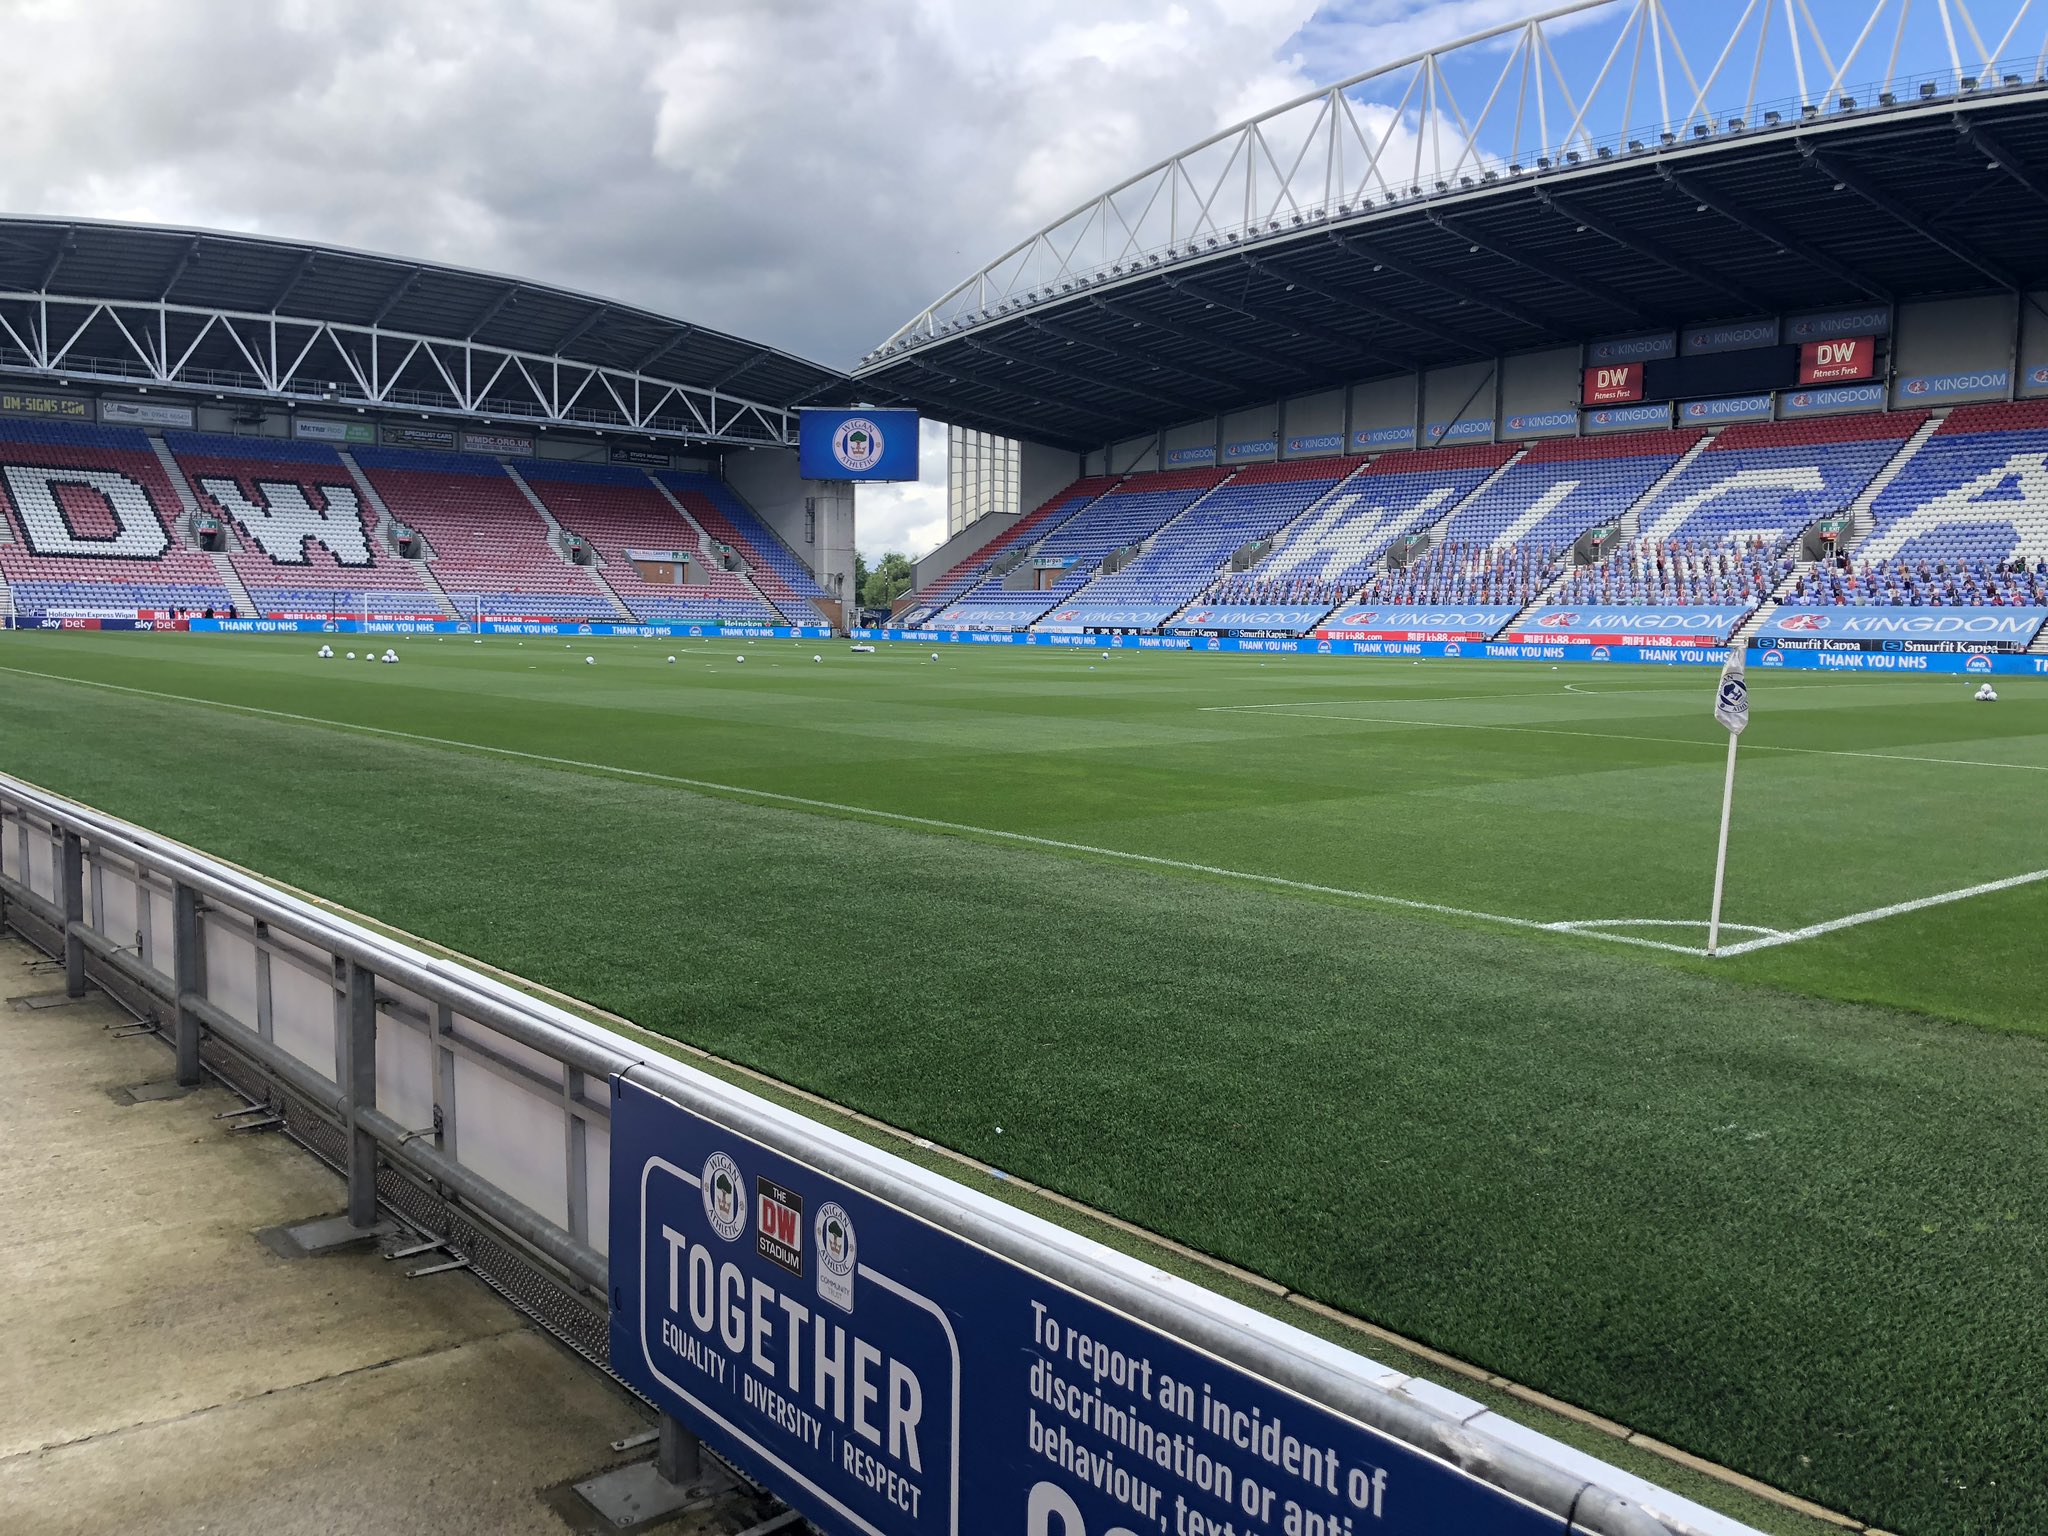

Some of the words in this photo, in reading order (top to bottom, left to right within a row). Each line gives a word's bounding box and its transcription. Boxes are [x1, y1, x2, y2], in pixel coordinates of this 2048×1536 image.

[1820, 313, 1887, 332] KINGDOM
[1714, 327, 1774, 344] KINGDOM
[1618, 339, 1672, 355] KINGDOM
[1817, 342, 1856, 365] DW
[1597, 368, 1628, 388] DW
[1934, 373, 2006, 391] KINGDOM
[1817, 389, 1882, 405] KINGDOM
[1712, 398, 1770, 414] KINGDOM
[1528, 414, 1577, 428] KINGDOM
[1615, 408, 1668, 422] KINGDOM
[842, 420, 875, 433] WIGAN
[1448, 422, 1492, 434] KINGDOM
[404, 430, 436, 439] SPECIALIST
[437, 432, 452, 440] CARS
[466, 436, 530, 447] WMDC.ORG.UK
[1373, 429, 1415, 442] KINGDOM
[1305, 436, 1343, 449] KINGDOM
[840, 456, 875, 468] ATHLETIC
[2, 463, 373, 565] DW
[49, 611, 74, 619] Holiday
[1082, 612, 1170, 622] KINGDOM
[1219, 612, 1322, 623] KINGDOM
[1384, 613, 1511, 625] KINGDOM
[1587, 614, 1738, 628] KINGDOM
[42, 619, 61, 630] sky
[65, 618, 85, 628] bet
[134, 620, 154, 630] sky
[156, 620, 176, 629] bet
[218, 621, 253, 631] THANK
[255, 621, 276, 631] YOU
[278, 622, 298, 631] NHS
[363, 622, 398, 632] THANK
[399, 622, 414, 632] YOU
[416, 622, 434, 632] NHS
[494, 624, 522, 633] THANK
[523, 624, 540, 634] YOU
[541, 625, 558, 634] NHS
[1843, 616, 2039, 633] KINGDOM
[612, 626, 643, 635] THANK
[644, 627, 655, 635] YOU
[655, 627, 671, 636] NHS
[720, 628, 743, 636] THANK
[744, 628, 759, 636] YOU
[760, 628, 774, 636] NHS
[901, 631, 916, 640] THANK
[918, 632, 927, 640] YOU
[928, 632, 938, 641] NHS
[1199, 629, 1218, 637] Kappa
[1239, 630, 1265, 638] Smurfit
[972, 634, 990, 642] THANK
[990, 634, 1002, 642] YOU
[1002, 634, 1013, 643] NHS
[1050, 636, 1070, 644] THANK
[1071, 636, 1084, 644] YOU
[1084, 637, 1096, 645] NHS
[1138, 638, 1160, 646] THANK
[1161, 638, 1176, 647] YOU
[1176, 639, 1190, 648] NHS
[1777, 639, 1822, 650] Smurfit
[1822, 640, 1861, 651] Kappa
[1238, 641, 1264, 650] THANK
[1265, 642, 1281, 650] YOU
[1282, 642, 1298, 651] NHS
[1353, 642, 1382, 653] THANK
[1383, 643, 1402, 653] YOU
[1403, 644, 1421, 654] NHS
[1486, 646, 1518, 656] THANK
[1521, 646, 1542, 657] YOU
[1544, 647, 1565, 658] NHS
[1904, 640, 1955, 653] Smurfit
[1956, 642, 1999, 654] Kappa
[1639, 650, 1677, 661] THANK
[1680, 650, 1707, 662] YOU
[1710, 651, 1730, 662] NHS
[1818, 654, 1863, 667] THANK
[1867, 655, 1896, 668] YOU
[1898, 655, 1928, 668] NHS
[709, 1155, 741, 1182] WIGAN
[772, 1187, 787, 1203] THE
[708, 1208, 739, 1236] ATHLETIC
[762, 1198, 797, 1247] DW
[821, 1205, 850, 1228] WIGAN
[759, 1238, 800, 1270] STADIUM
[820, 1250, 850, 1273] ATHLETIC
[820, 1274, 850, 1296] COMMUNITY
[828, 1286, 843, 1300] TRUST
[662, 1224, 923, 1474] TOGETHER
[1031, 1299, 1060, 1352] To
[1066, 1328, 1152, 1400] report
[1159, 1374, 1195, 1423] an
[1202, 1383, 1340, 1496] incident
[1349, 1466, 1388, 1519] of
[662, 1318, 726, 1384] EQUALITY
[744, 1373, 822, 1450] DIVERSITY
[843, 1440, 922, 1519] RESPECT
[1030, 1358, 1233, 1504] discrimination
[1241, 1477, 1276, 1524] or
[1029, 1408, 1168, 1534] behaviour,
